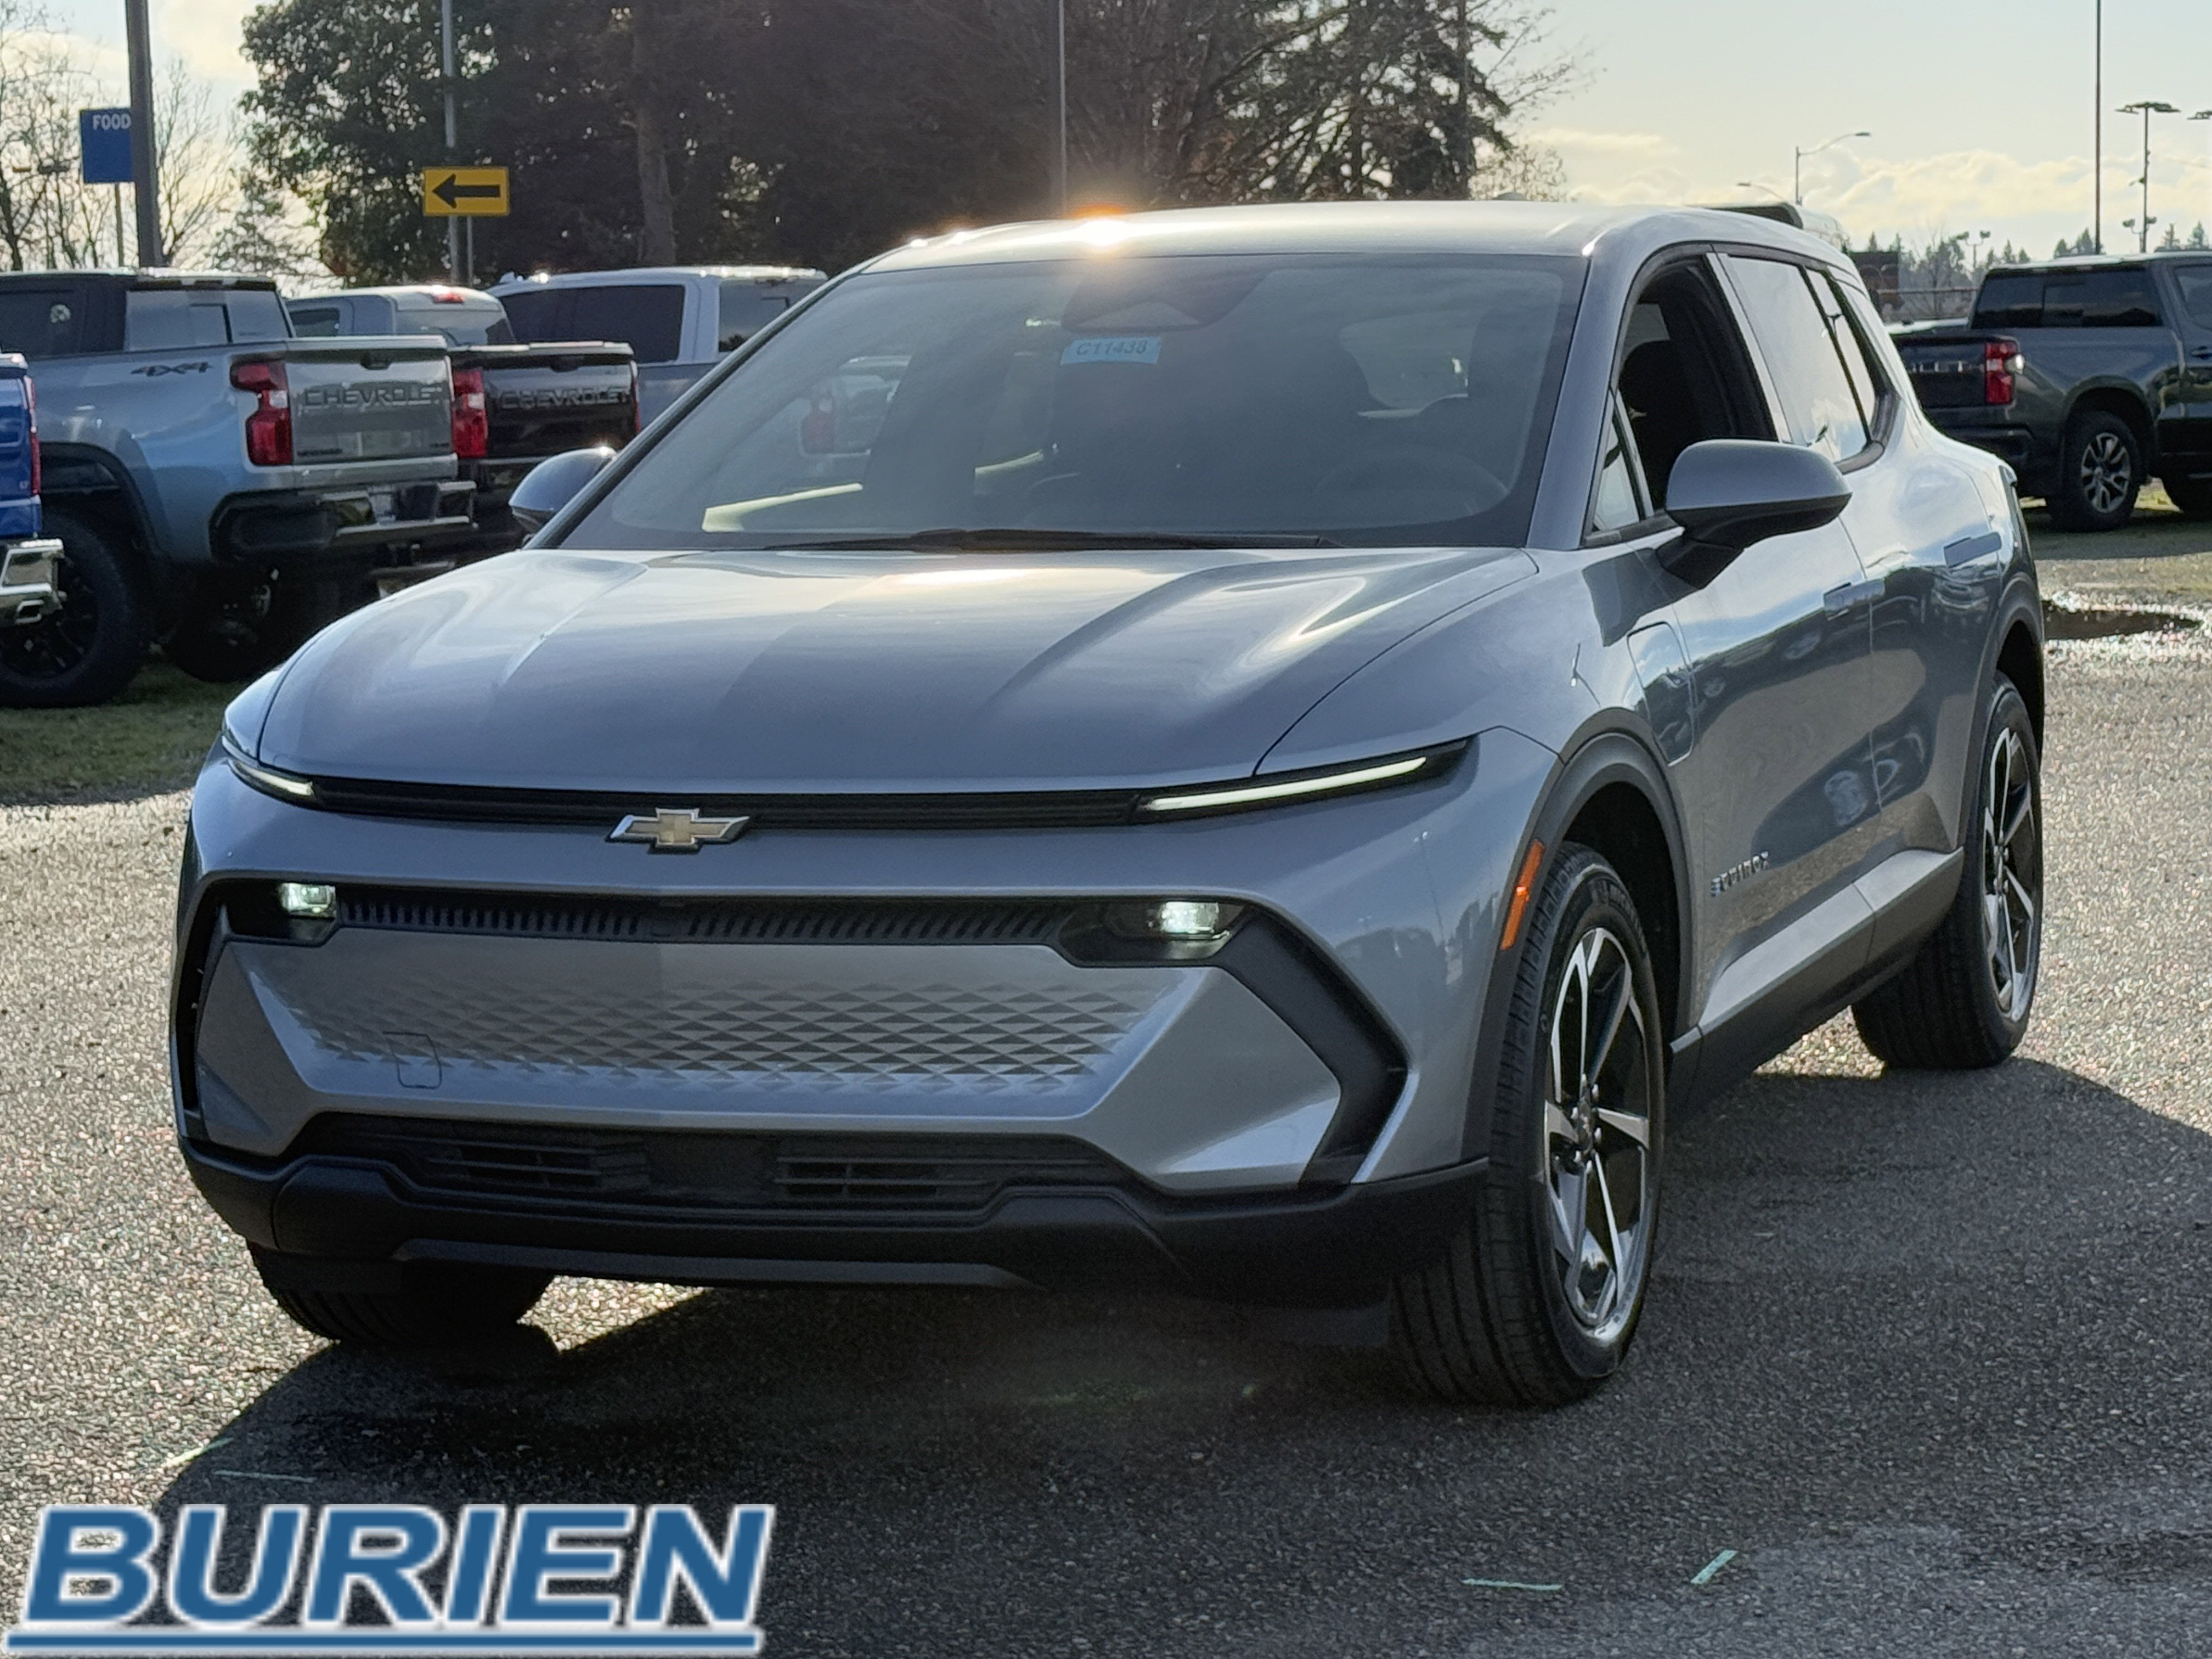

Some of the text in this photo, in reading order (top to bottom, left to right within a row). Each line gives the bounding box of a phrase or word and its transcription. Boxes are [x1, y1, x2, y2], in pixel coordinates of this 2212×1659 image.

[92, 113, 132, 131] FOOD
[1076, 340, 1148, 356] C11438
[304, 386, 444, 409] CHEVROLET
[500, 386, 631, 409] CHEVROLET
